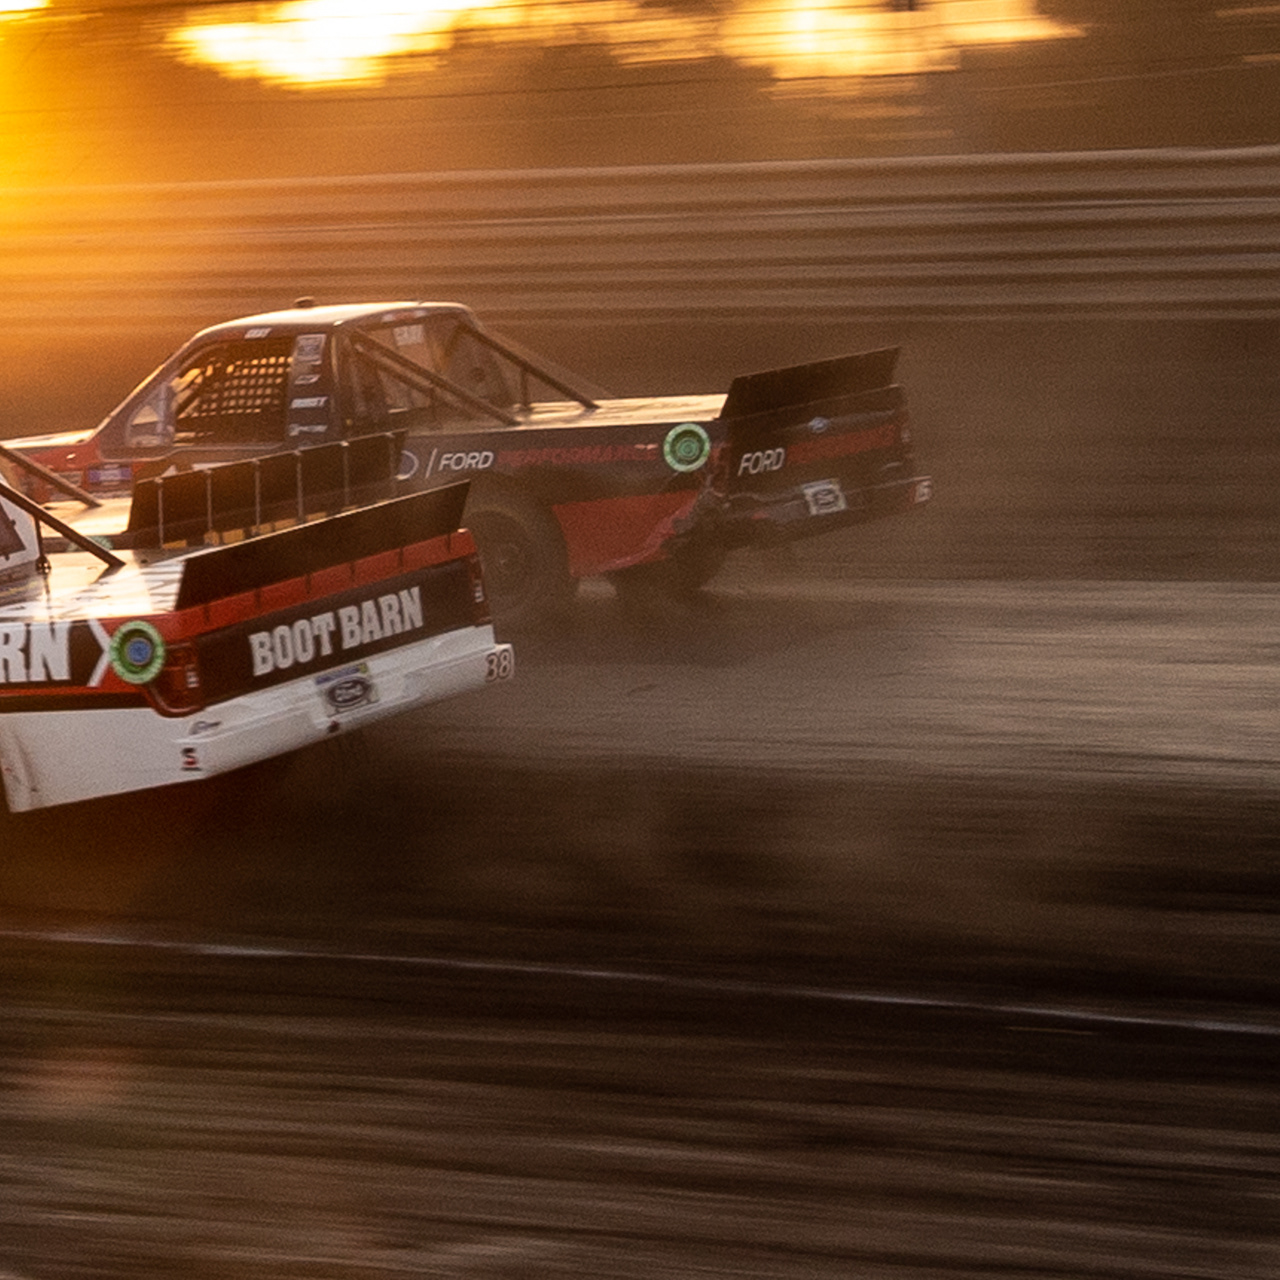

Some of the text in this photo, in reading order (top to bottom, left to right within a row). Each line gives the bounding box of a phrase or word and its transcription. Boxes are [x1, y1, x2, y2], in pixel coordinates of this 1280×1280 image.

[438, 451, 494, 472] FORD
[738, 447, 786, 477] FORD
[248, 585, 425, 677] BOOT BARN
[484, 647, 515, 683] 38
